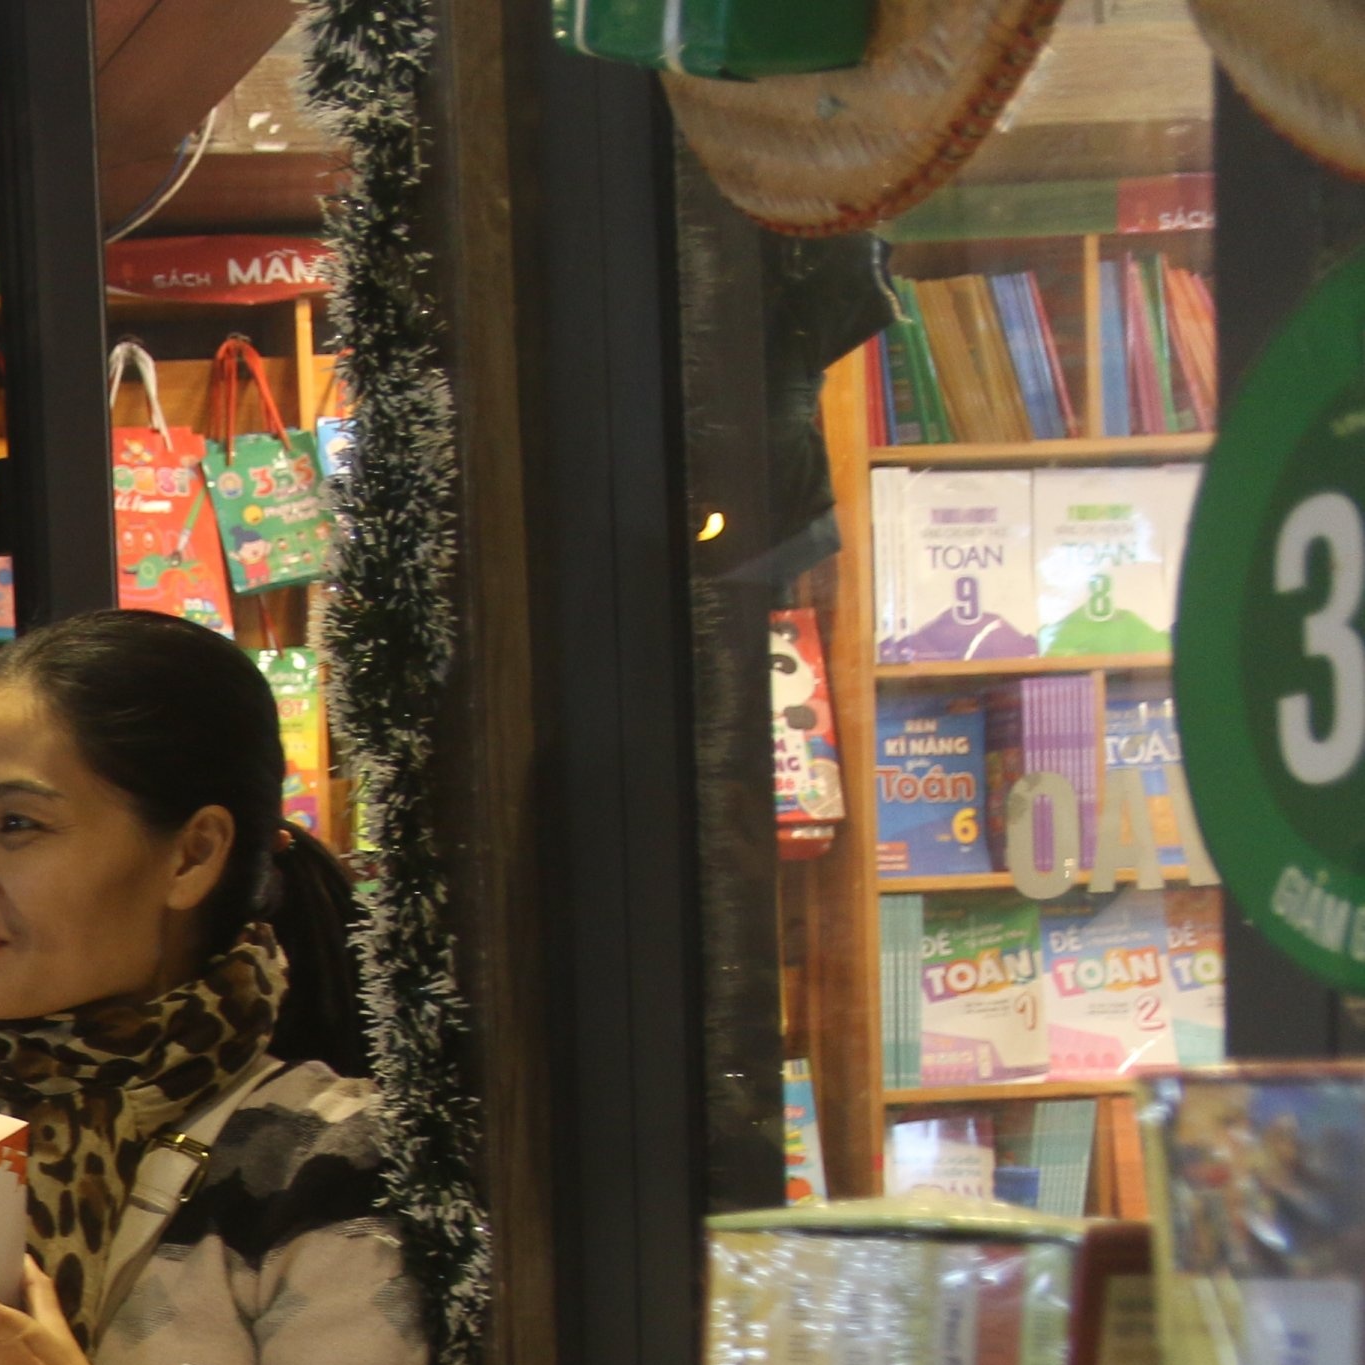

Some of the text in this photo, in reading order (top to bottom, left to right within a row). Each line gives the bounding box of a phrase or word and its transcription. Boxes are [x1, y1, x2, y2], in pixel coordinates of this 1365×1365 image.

[955, 576, 979, 621] 9
[1087, 573, 1112, 618] 8
[874, 763, 977, 804] Toán
[951, 806, 980, 845] 6
[1053, 949, 1164, 990] TOÁN
[1136, 996, 1168, 1031] 2
